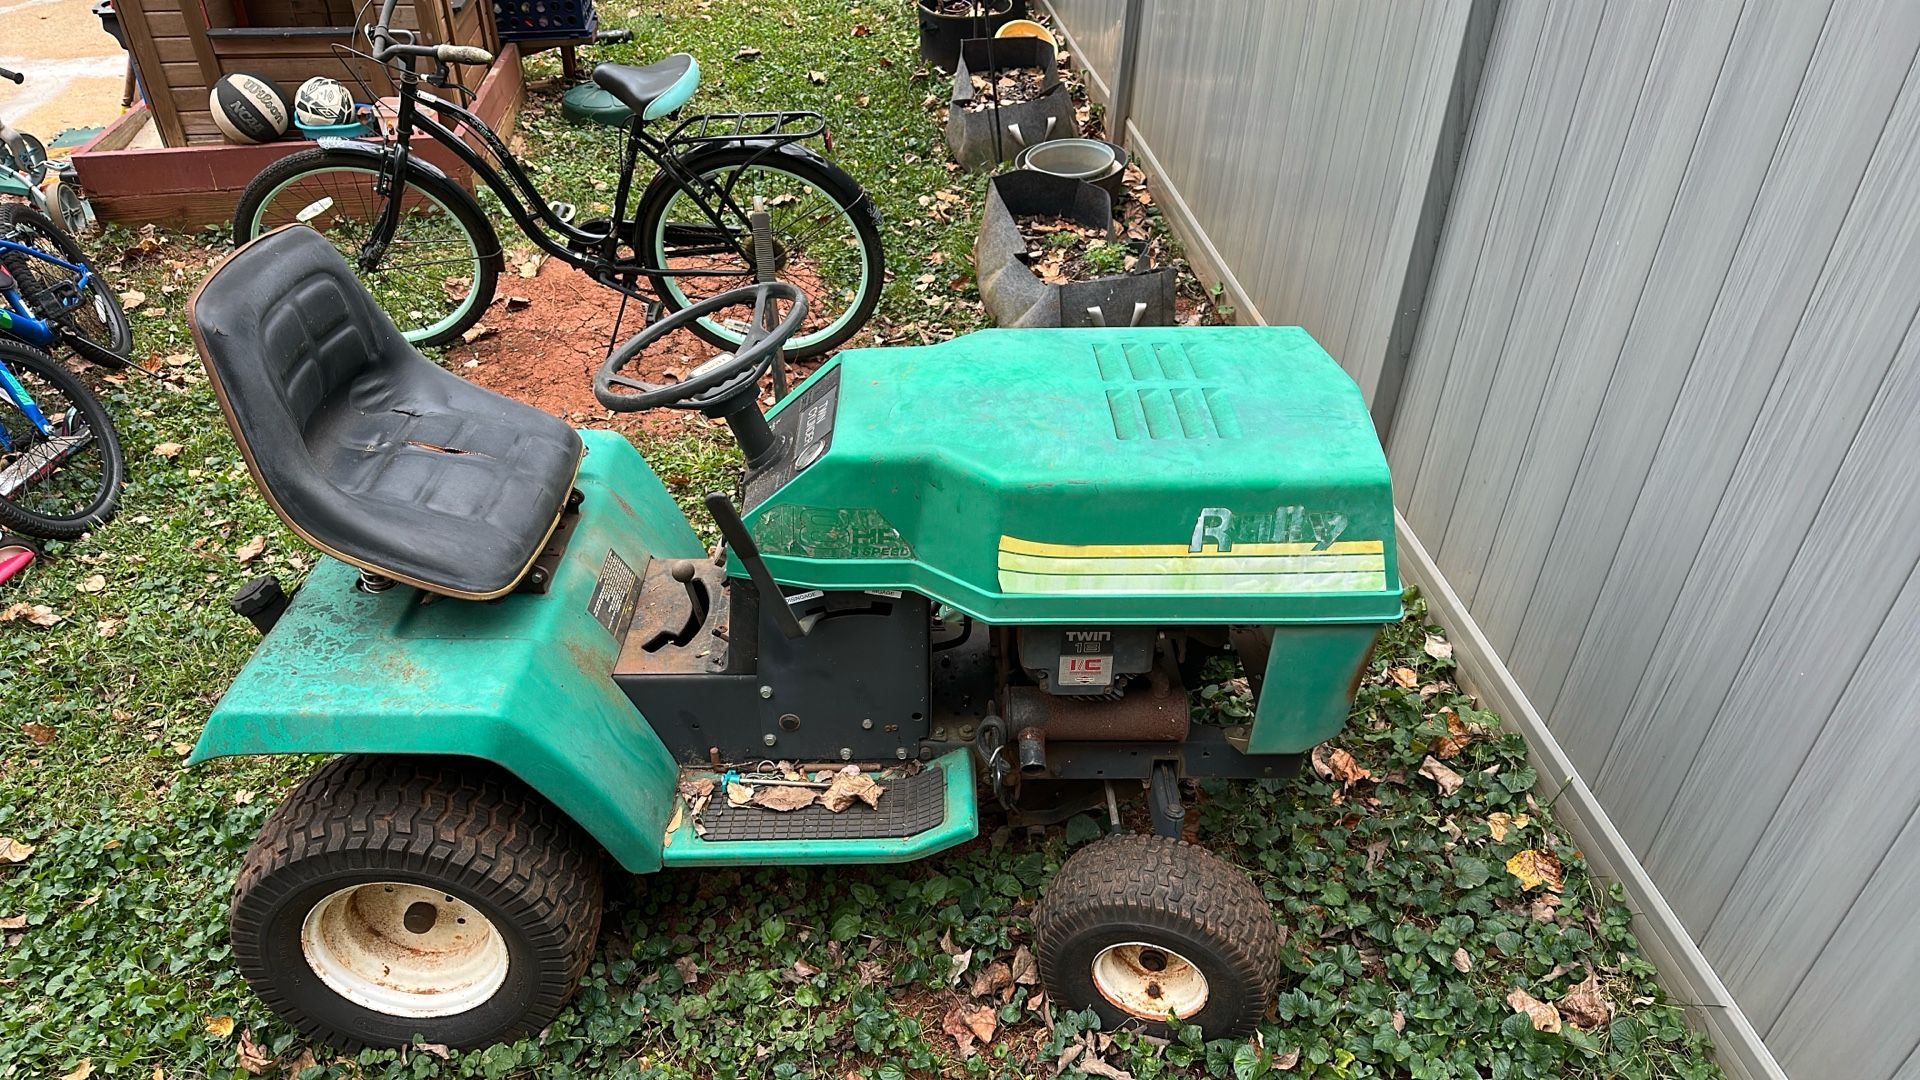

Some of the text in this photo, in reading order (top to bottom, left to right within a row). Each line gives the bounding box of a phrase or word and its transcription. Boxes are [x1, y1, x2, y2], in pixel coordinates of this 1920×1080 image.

[243, 78, 284, 125] Wilson
[229, 100, 265, 133] NCAA
[815, 399, 829, 425] TWIN
[803, 406, 818, 447] CYLINDER
[863, 546, 910, 557] SPEED
[1065, 631, 1111, 642] TWIN
[1074, 642, 1101, 653] 18
[1070, 659, 1102, 671] I/C
